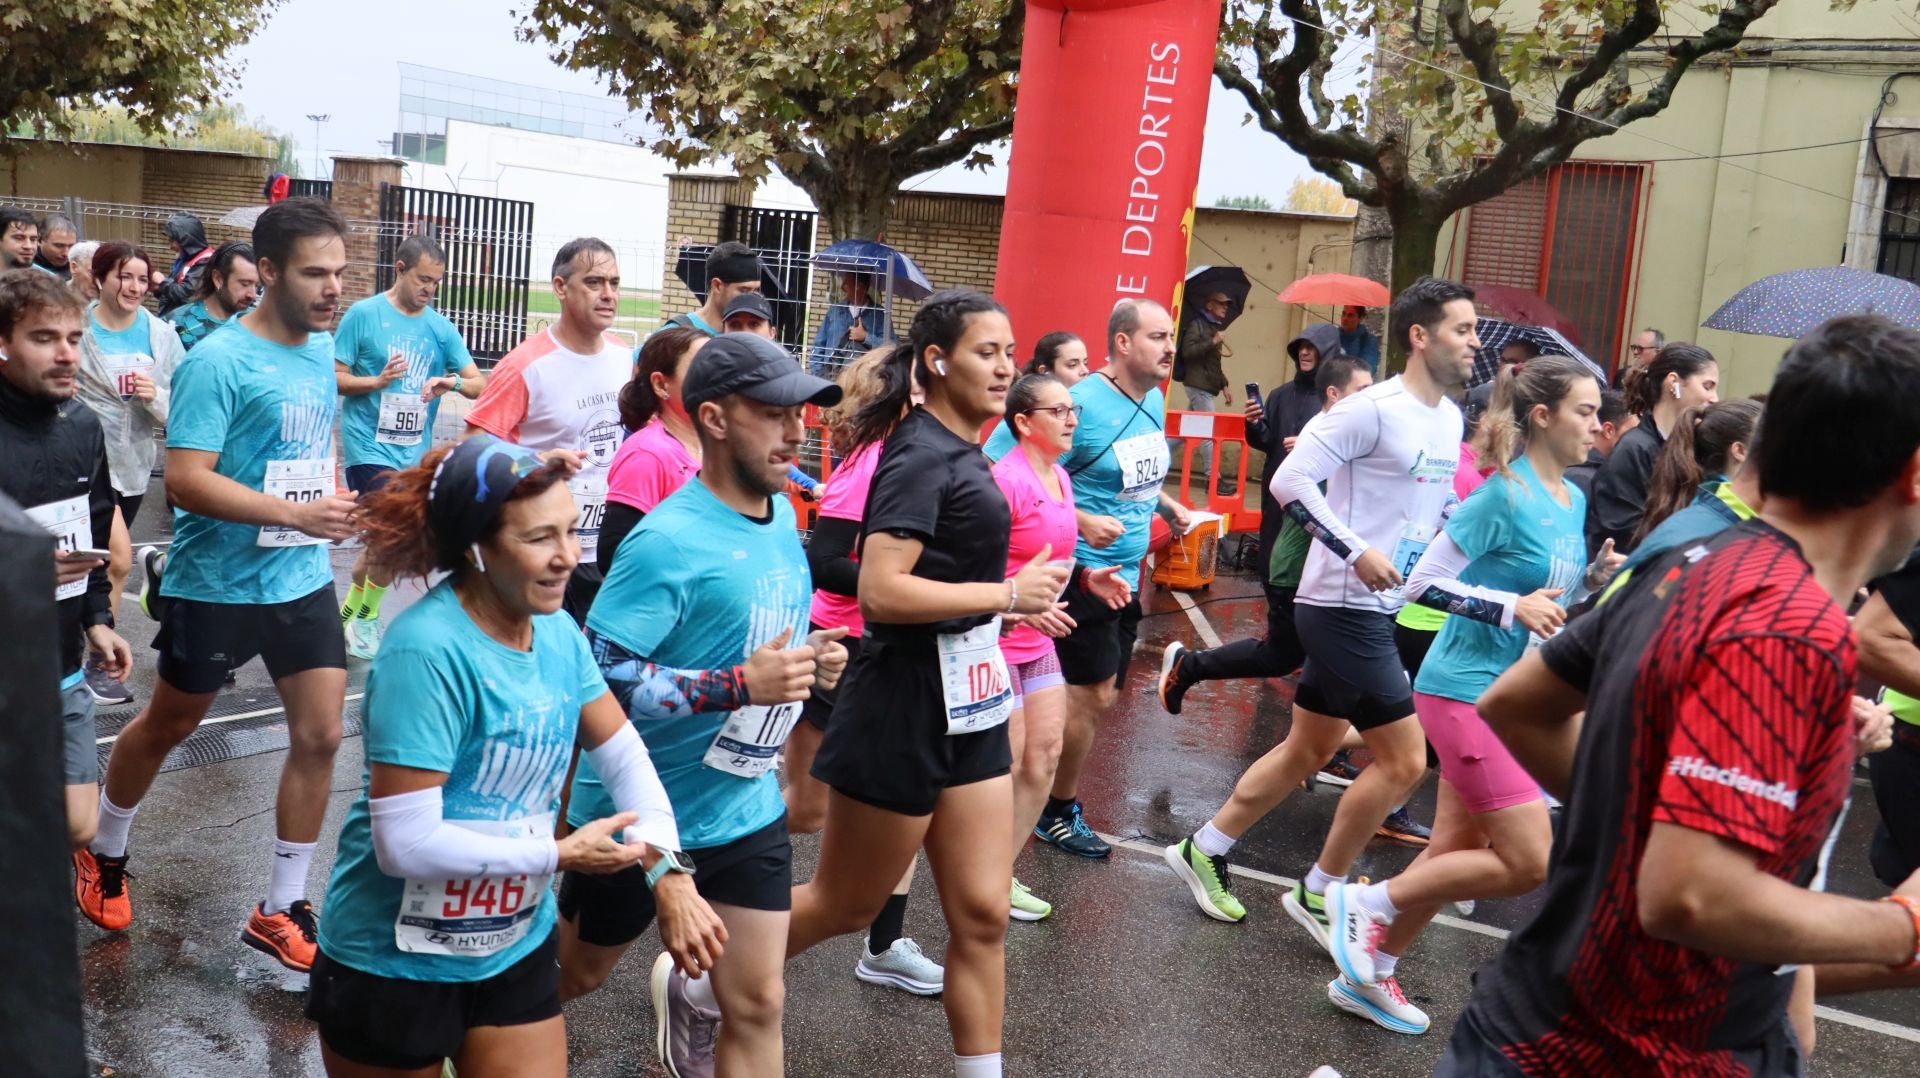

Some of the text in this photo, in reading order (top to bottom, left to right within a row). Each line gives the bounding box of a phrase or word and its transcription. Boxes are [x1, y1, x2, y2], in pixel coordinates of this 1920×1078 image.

[1121, 42, 1181, 257] DEPORTES
[587, 393, 605, 408] CASA
[395, 411, 419, 431] 961
[1135, 456, 1159, 485] 824
[441, 874, 529, 919] 946
